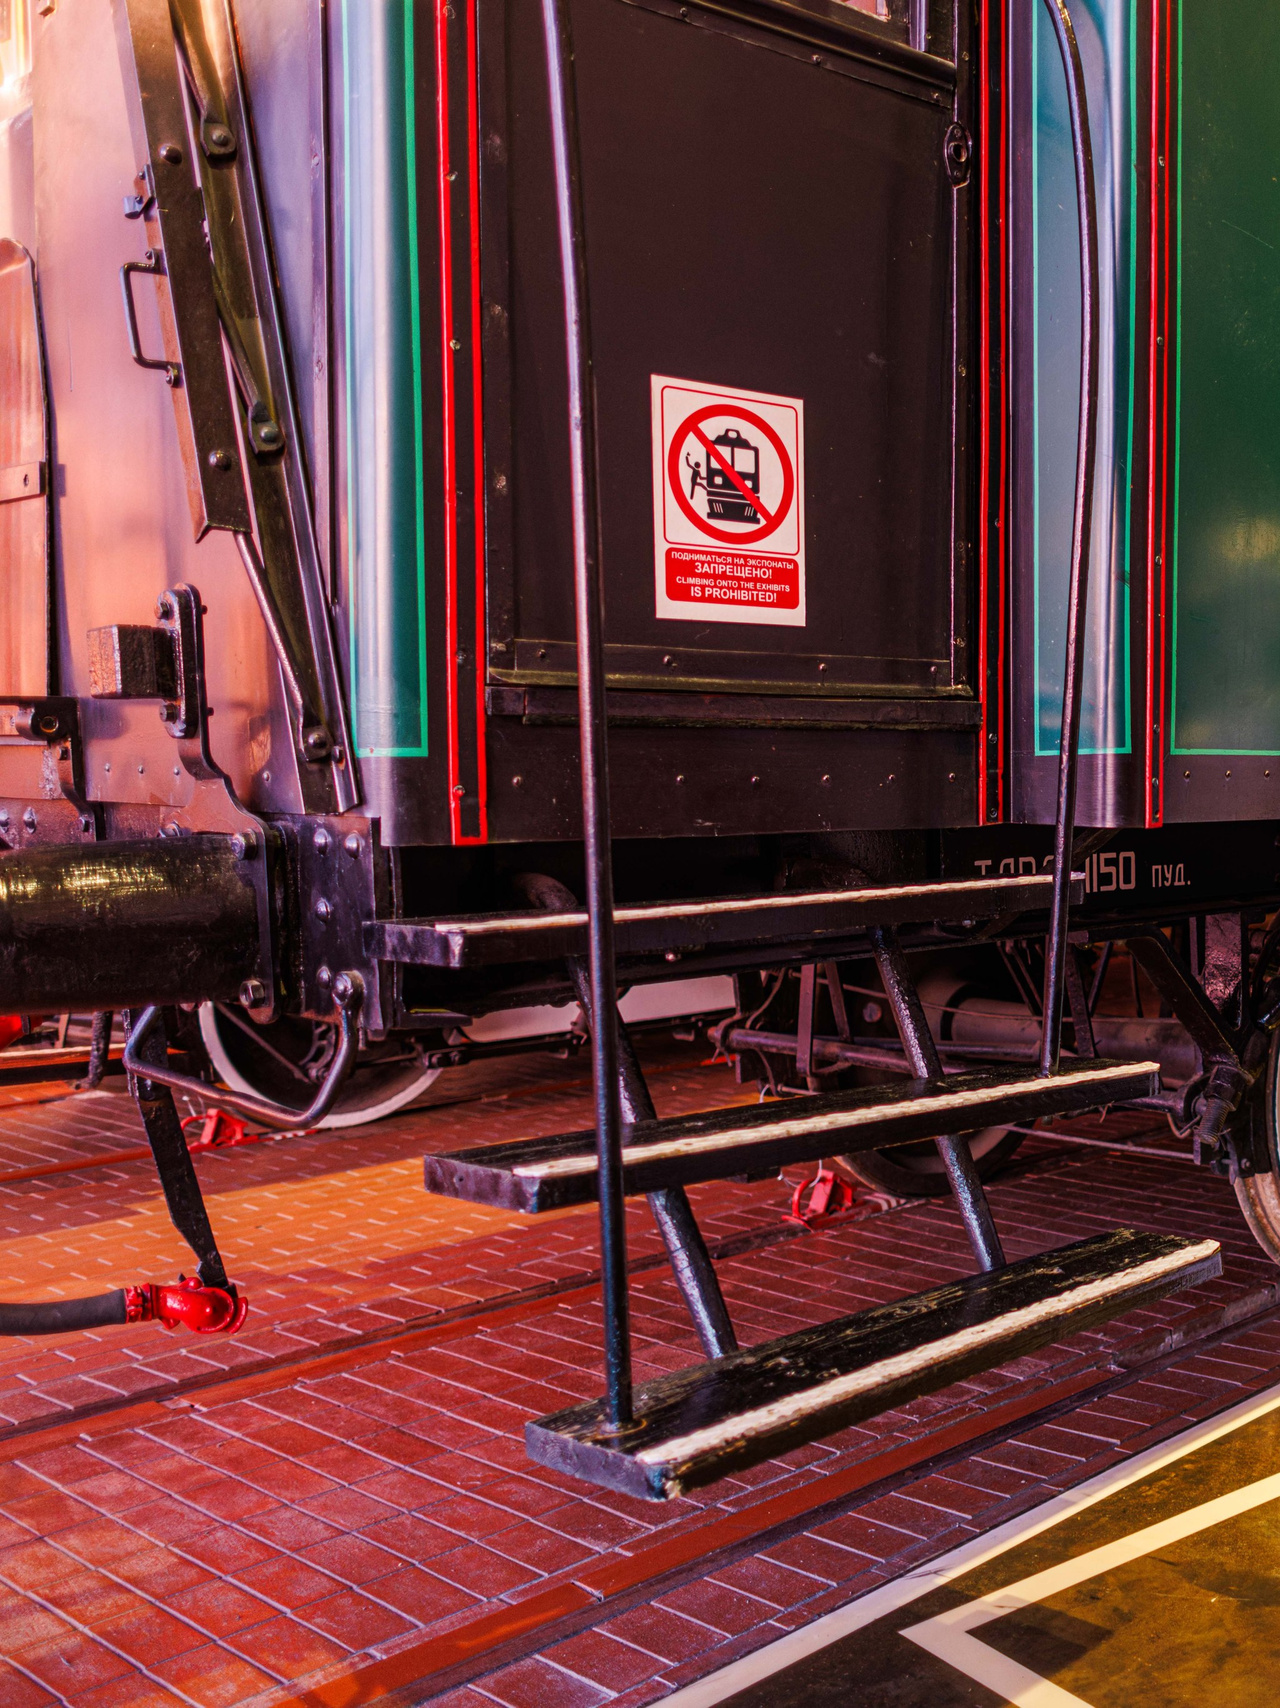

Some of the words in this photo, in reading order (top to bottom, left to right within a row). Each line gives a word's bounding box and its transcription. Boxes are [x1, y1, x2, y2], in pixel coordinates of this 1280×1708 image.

[671, 551, 732, 564] ПОДНИМАТЬСЯ
[734, 557, 745, 565] НА
[747, 558, 794, 570] ЭКСПОНАТЫ
[695, 562, 773, 579] ЗАПРЕЩЕНО!
[676, 576, 715, 586] CLIMBING
[716, 580, 739, 588] ONTO
[740, 581, 755, 590] THE
[756, 583, 790, 592] EXHIBITS
[690, 586, 702, 597] IS
[705, 588, 777, 603] PROHIBITED!
